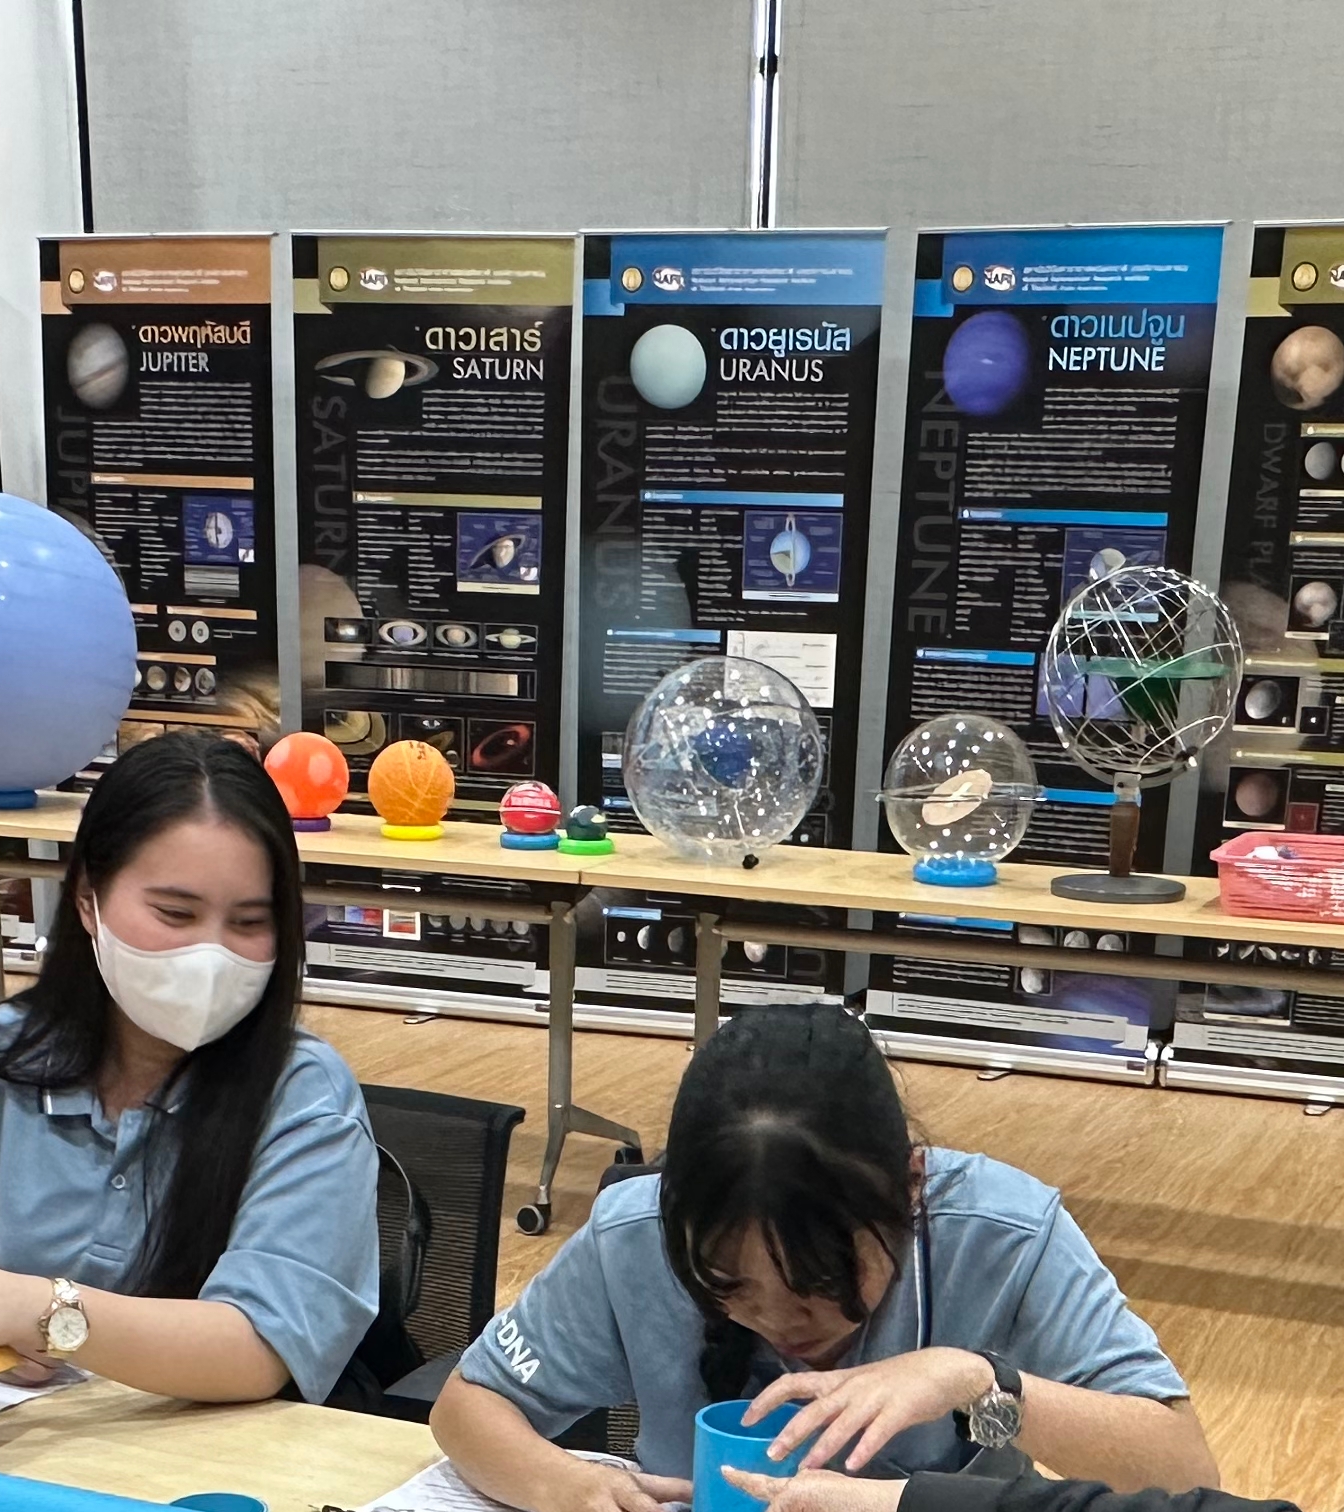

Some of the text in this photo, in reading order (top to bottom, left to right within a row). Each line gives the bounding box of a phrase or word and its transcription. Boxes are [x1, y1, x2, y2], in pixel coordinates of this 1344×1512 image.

[425, 321, 544, 352] ดาวเสาร์
[720, 321, 851, 358] ดาวยูเรนัส
[1050, 308, 1185, 345] ดาวเนปจูน
[139, 352, 210, 373] JUPITER
[452, 357, 544, 381] SATURN
[720, 357, 824, 382] URANUS
[1048, 346, 1165, 371] NEPTUNE
[56, 403, 89, 508] JUPI
[310, 395, 349, 571] SATURN
[593, 374, 639, 609] URANUS
[907, 369, 959, 636] NEPTUNE
[497, 1312, 540, 1384] -DNA
